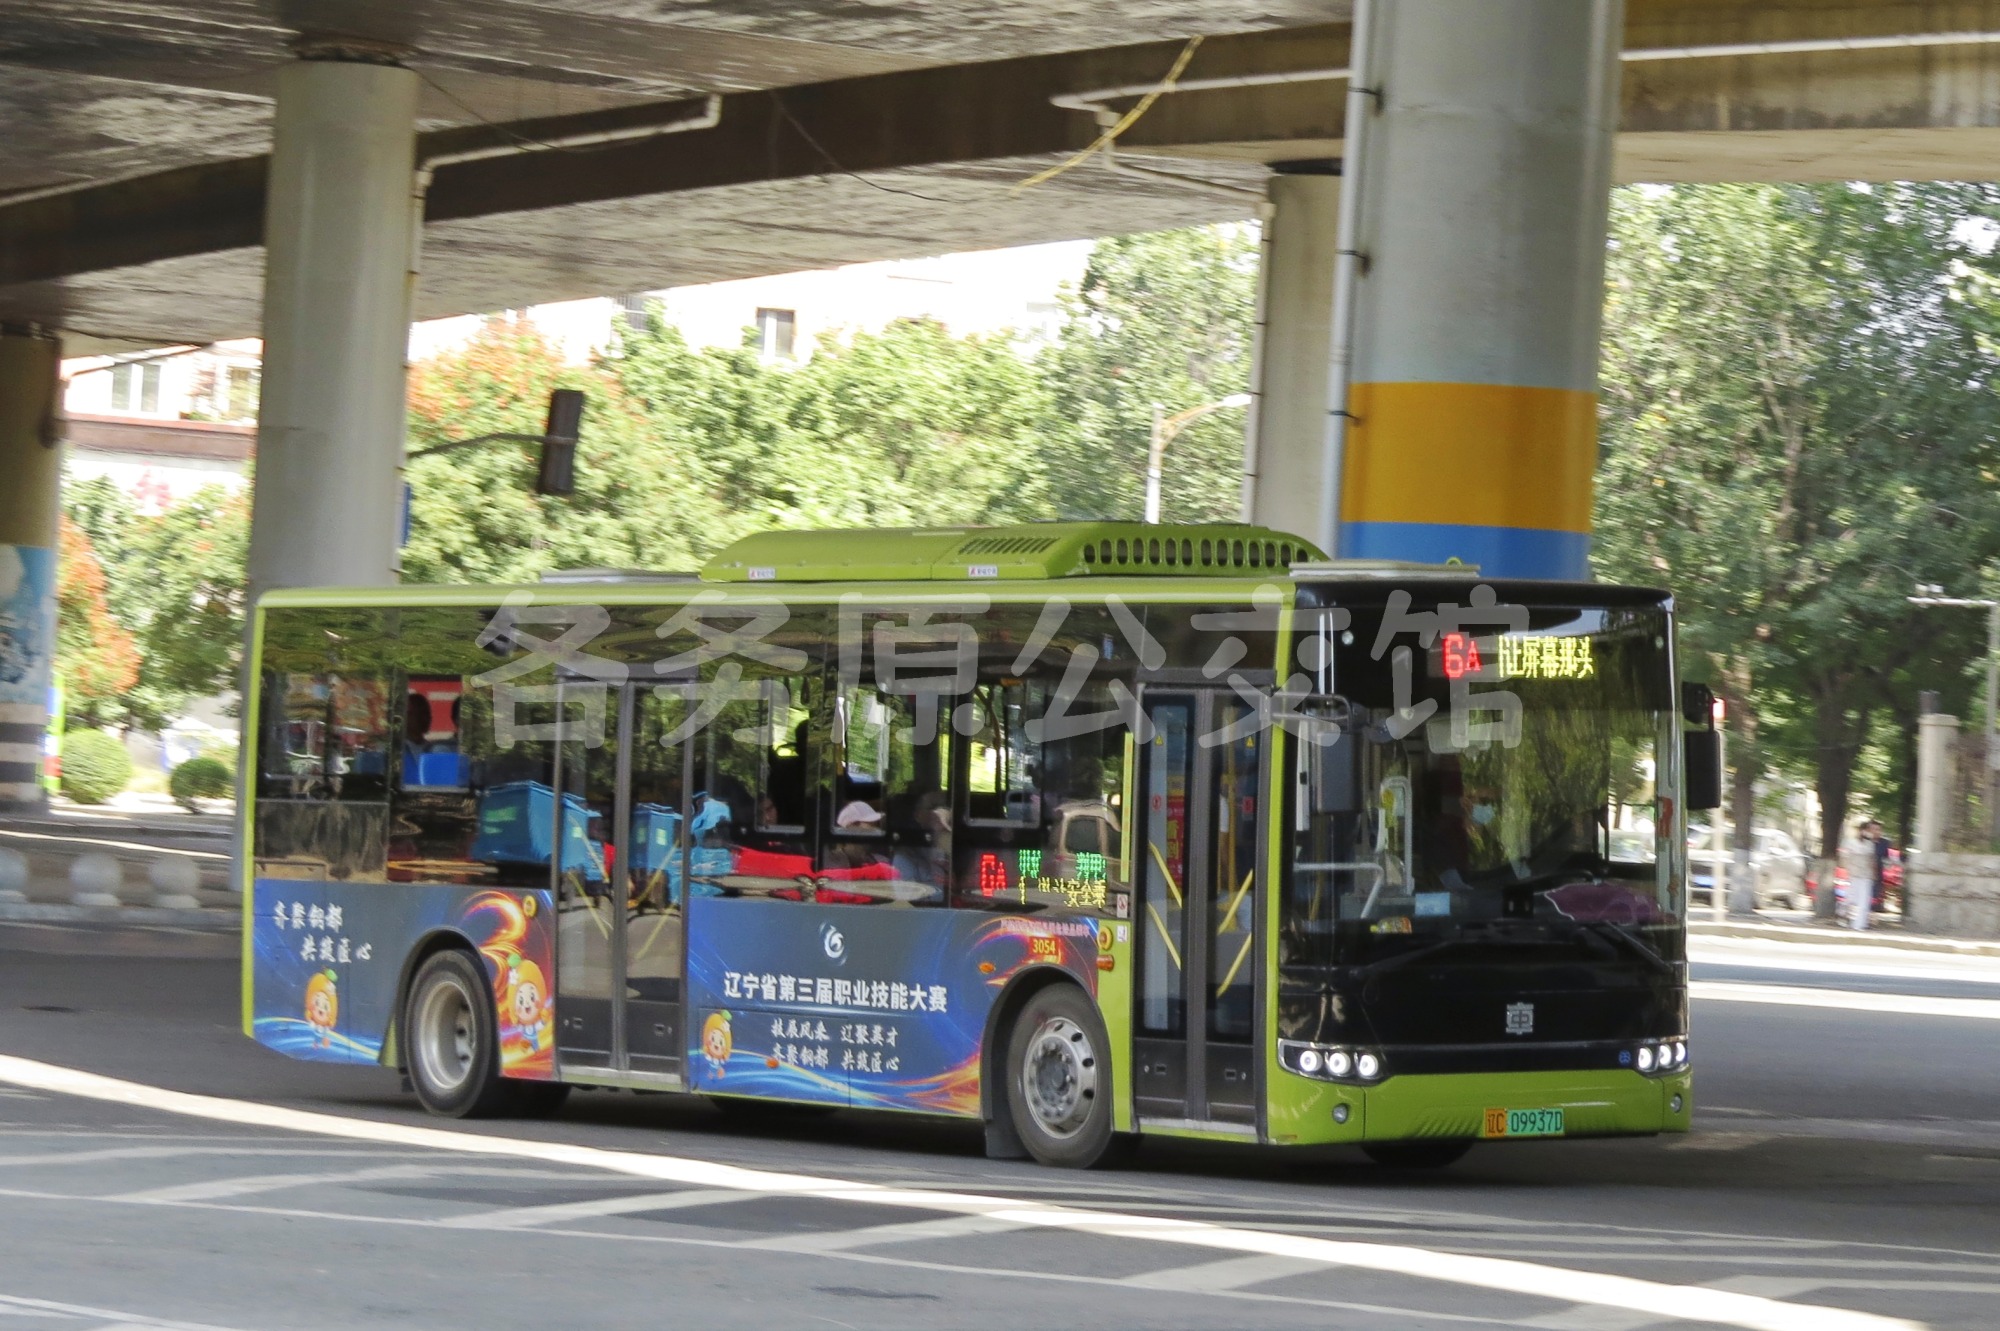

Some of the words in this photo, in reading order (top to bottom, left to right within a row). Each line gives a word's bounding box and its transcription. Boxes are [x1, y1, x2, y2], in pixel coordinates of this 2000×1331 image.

[1442, 634, 1482, 678] 6A
[1032, 938, 1056, 954] 3054
[723, 970, 948, 1013] 辽宁省第三届职业技能大赛
